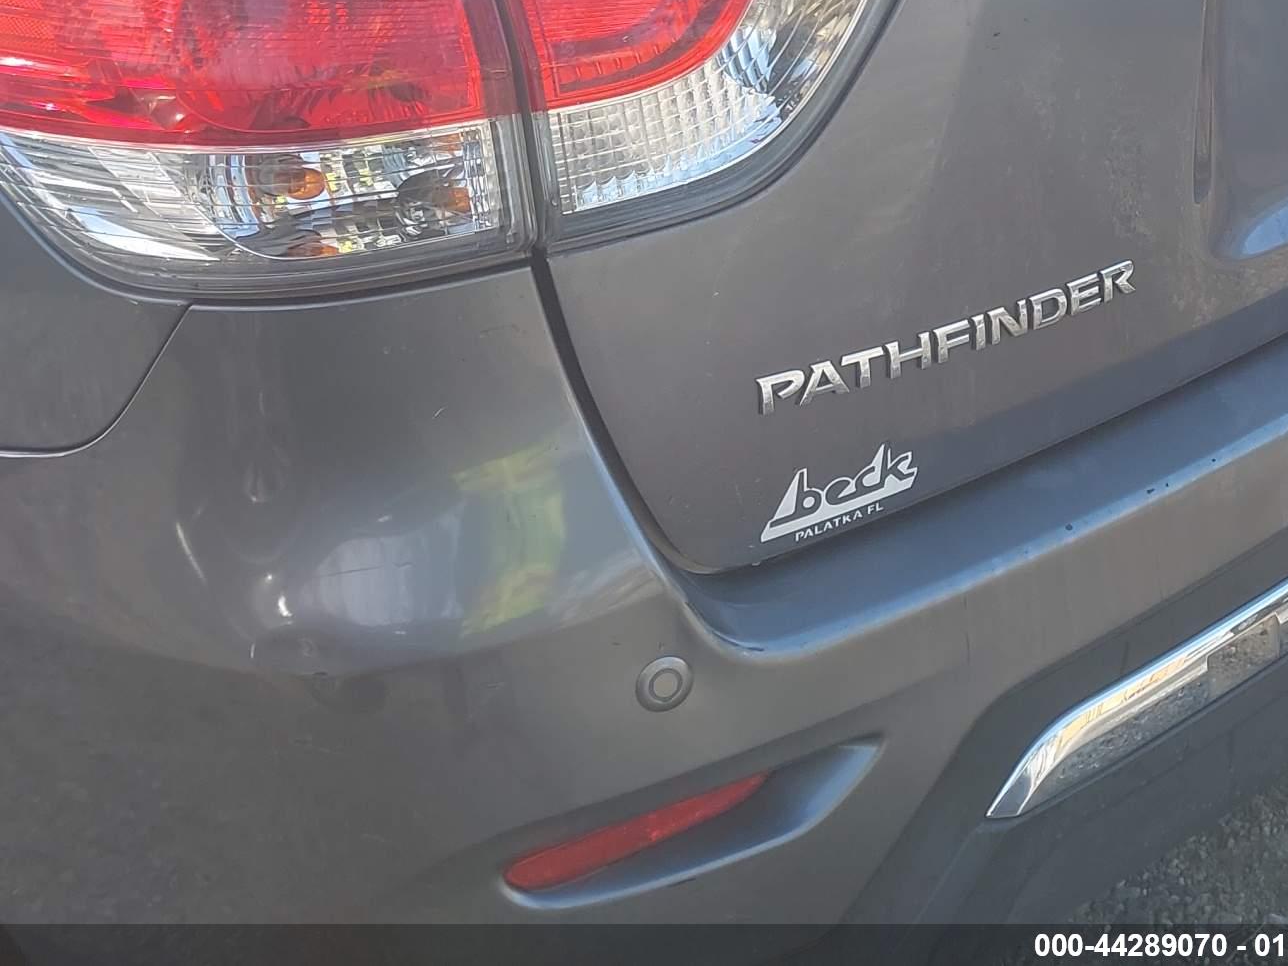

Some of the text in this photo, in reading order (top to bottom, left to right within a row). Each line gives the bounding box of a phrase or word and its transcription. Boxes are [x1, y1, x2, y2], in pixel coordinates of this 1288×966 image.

[756, 259, 1136, 416] PATHFINDER
[763, 443, 918, 538] beck
[795, 501, 884, 542] PALATKA FL
